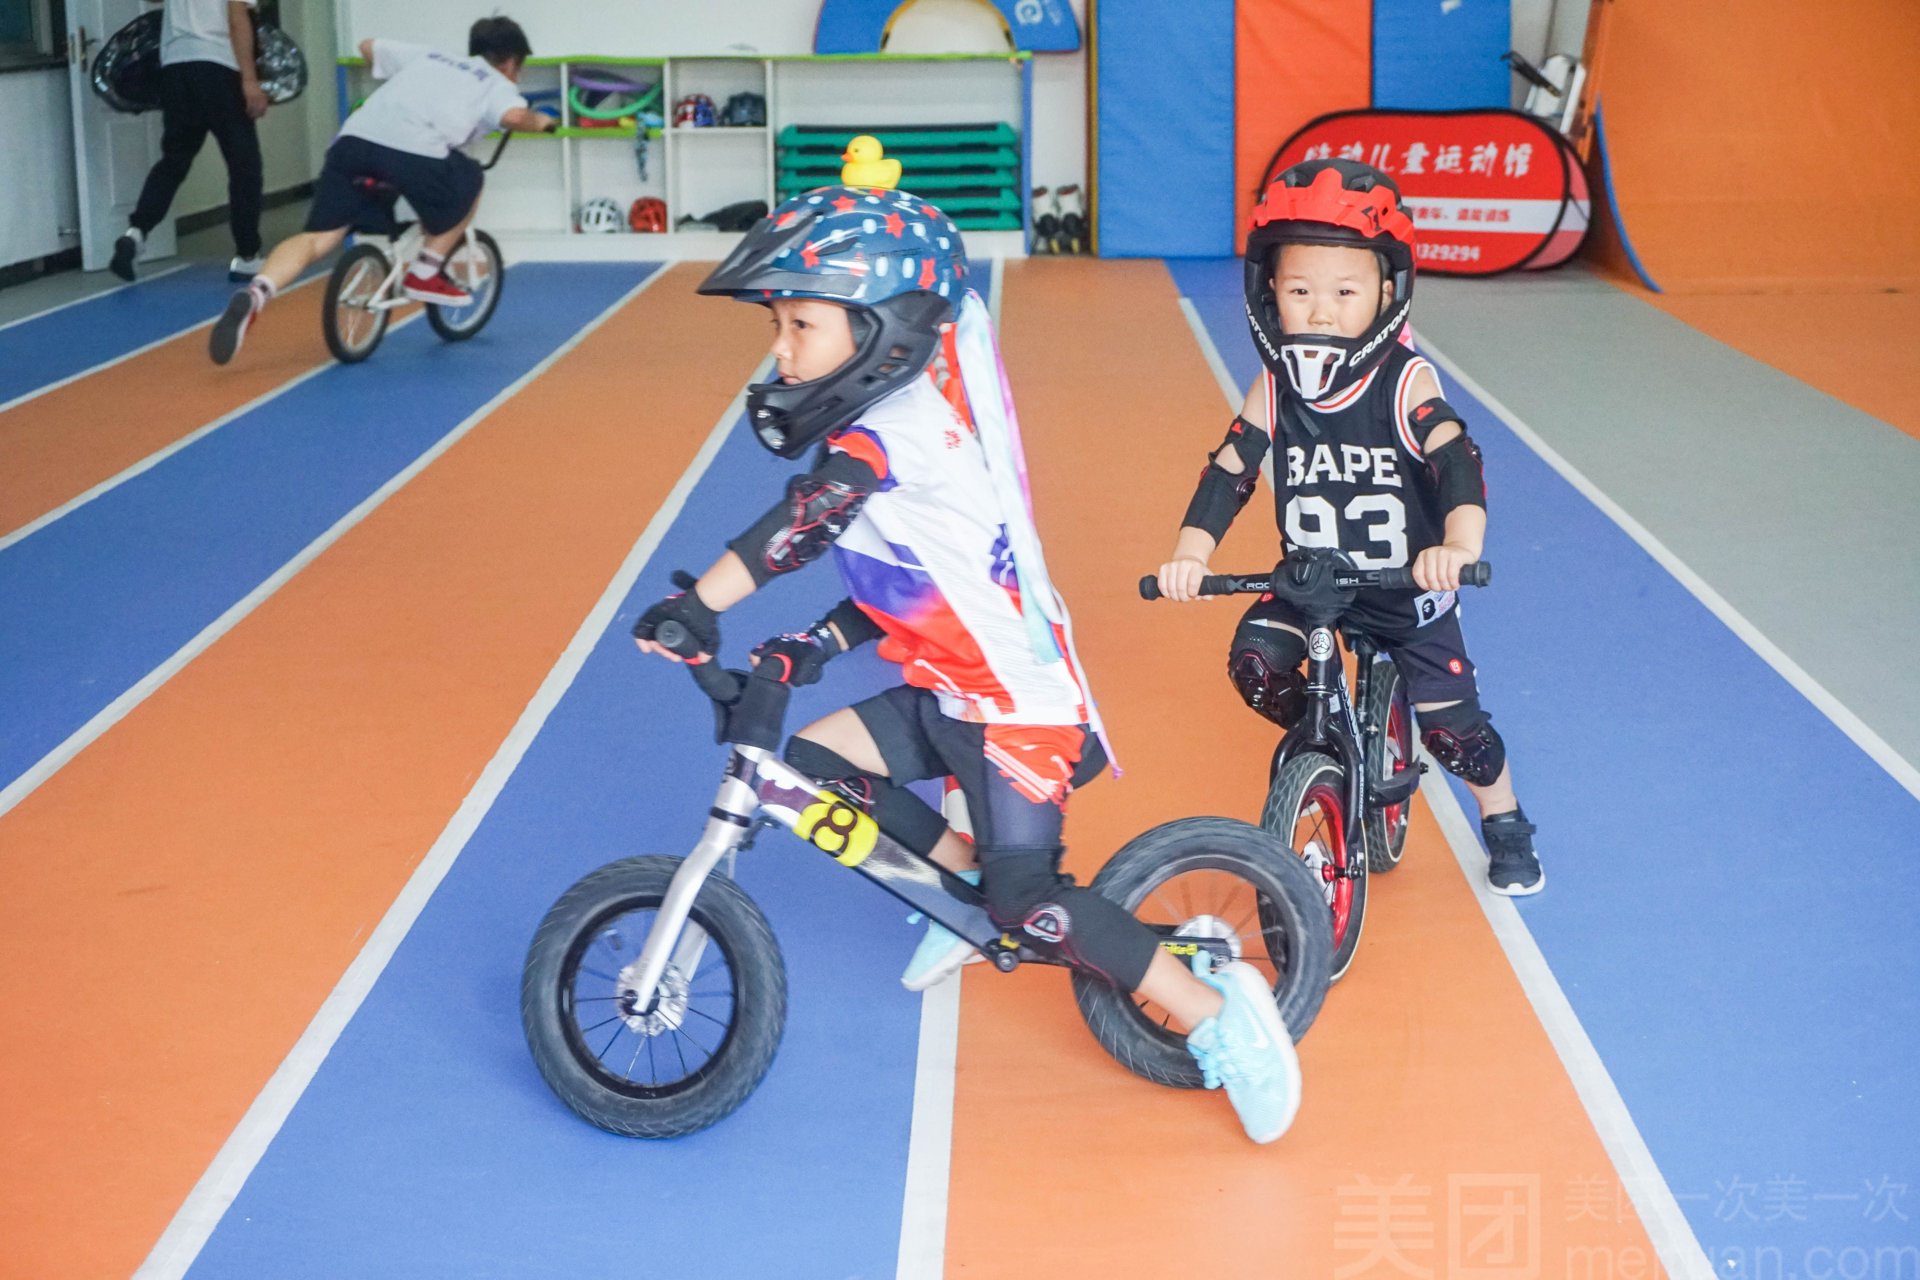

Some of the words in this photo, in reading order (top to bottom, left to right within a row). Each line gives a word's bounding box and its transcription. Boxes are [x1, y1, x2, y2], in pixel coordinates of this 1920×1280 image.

[1286, 443, 1402, 488] BAPE
[1285, 492, 1409, 571] 93
[810, 800, 857, 858] 8
